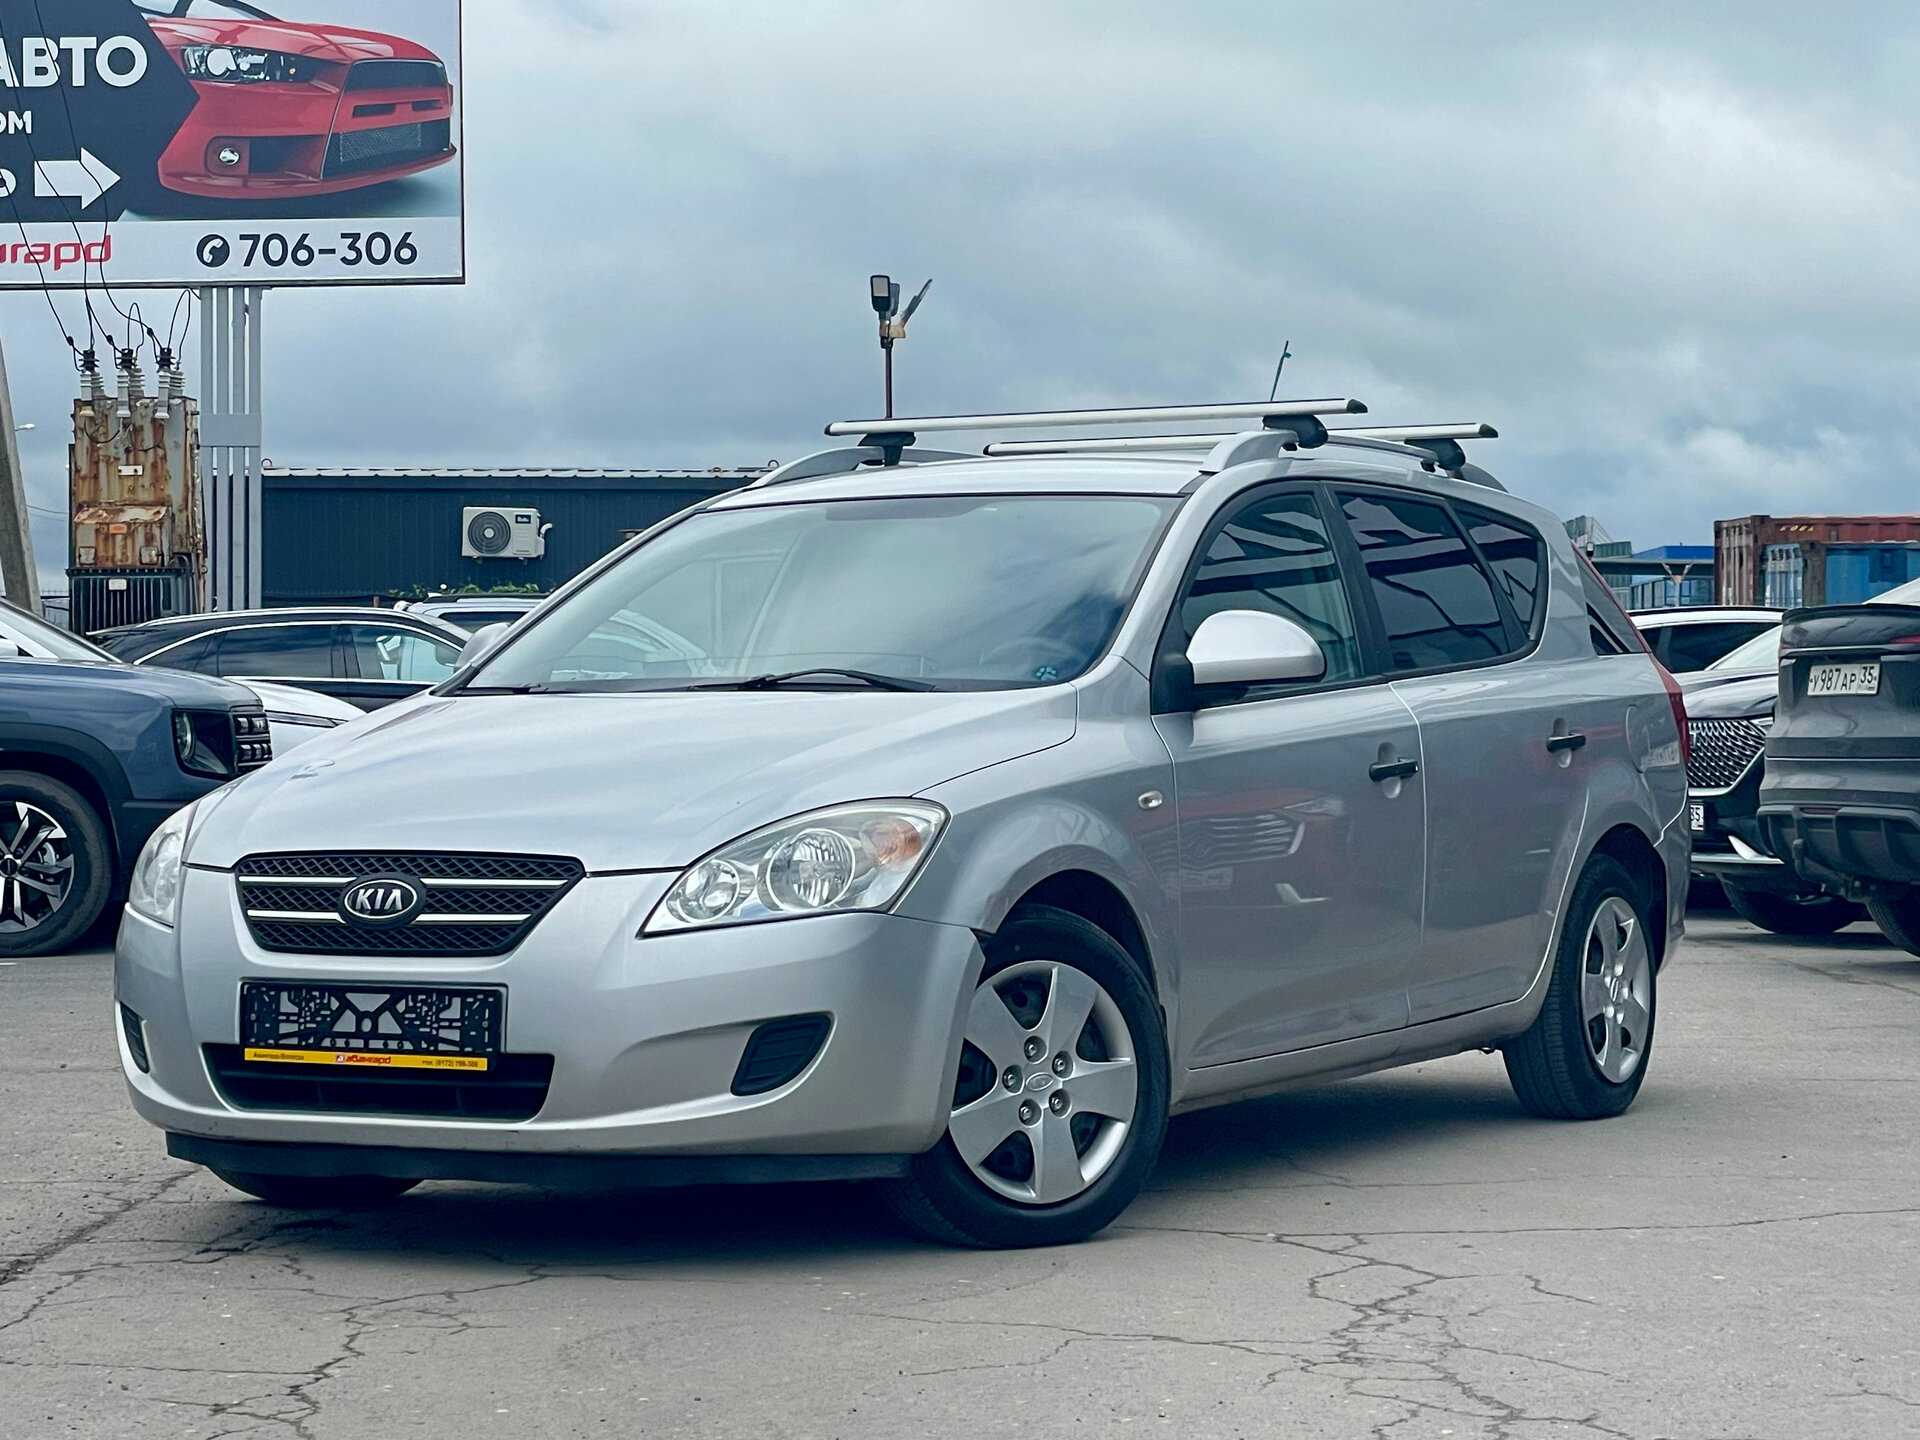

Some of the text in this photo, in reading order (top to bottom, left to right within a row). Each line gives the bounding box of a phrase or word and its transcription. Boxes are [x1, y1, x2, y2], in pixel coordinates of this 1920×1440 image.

[0, 110, 33, 135] М
[238, 231, 419, 268] 706-306
[1860, 665, 1875, 684] 35
[355, 888, 403, 910] KIA
